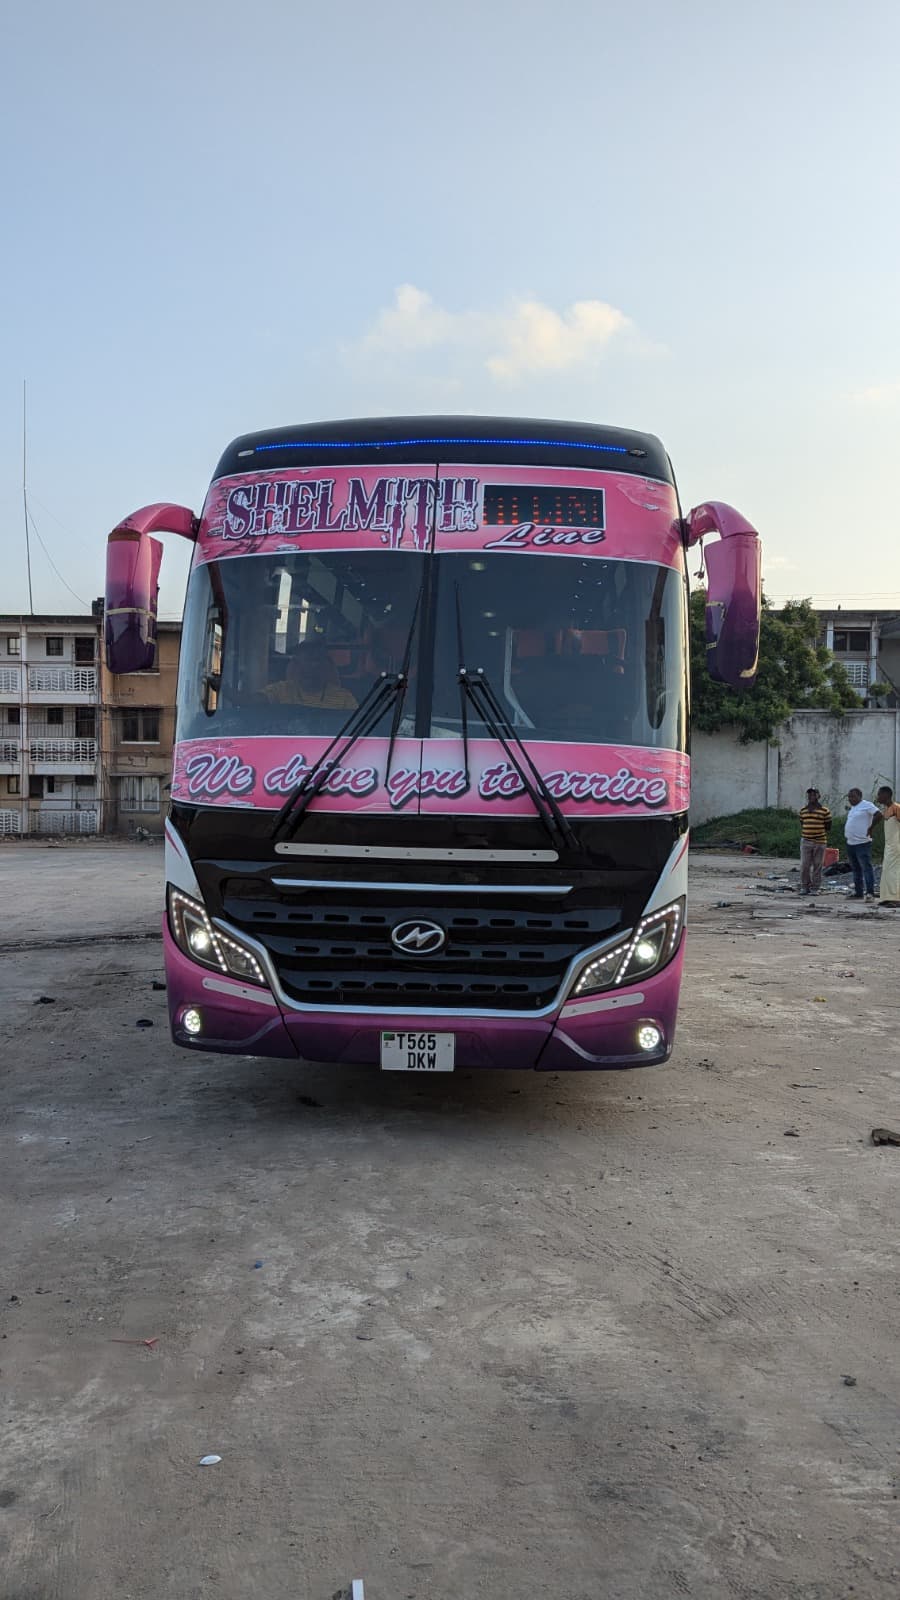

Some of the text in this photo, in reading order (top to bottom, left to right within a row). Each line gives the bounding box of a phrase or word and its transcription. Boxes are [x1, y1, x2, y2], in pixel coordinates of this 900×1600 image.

[223, 476, 480, 549] SHELMITH
[484, 522, 606, 549] Line
[185, 753, 253, 793] We
[387, 766, 470, 808] you
[479, 761, 526, 797] to
[537, 769, 667, 803] arrive
[396, 1033, 437, 1050] T565
[407, 1052, 437, 1069] DKW
